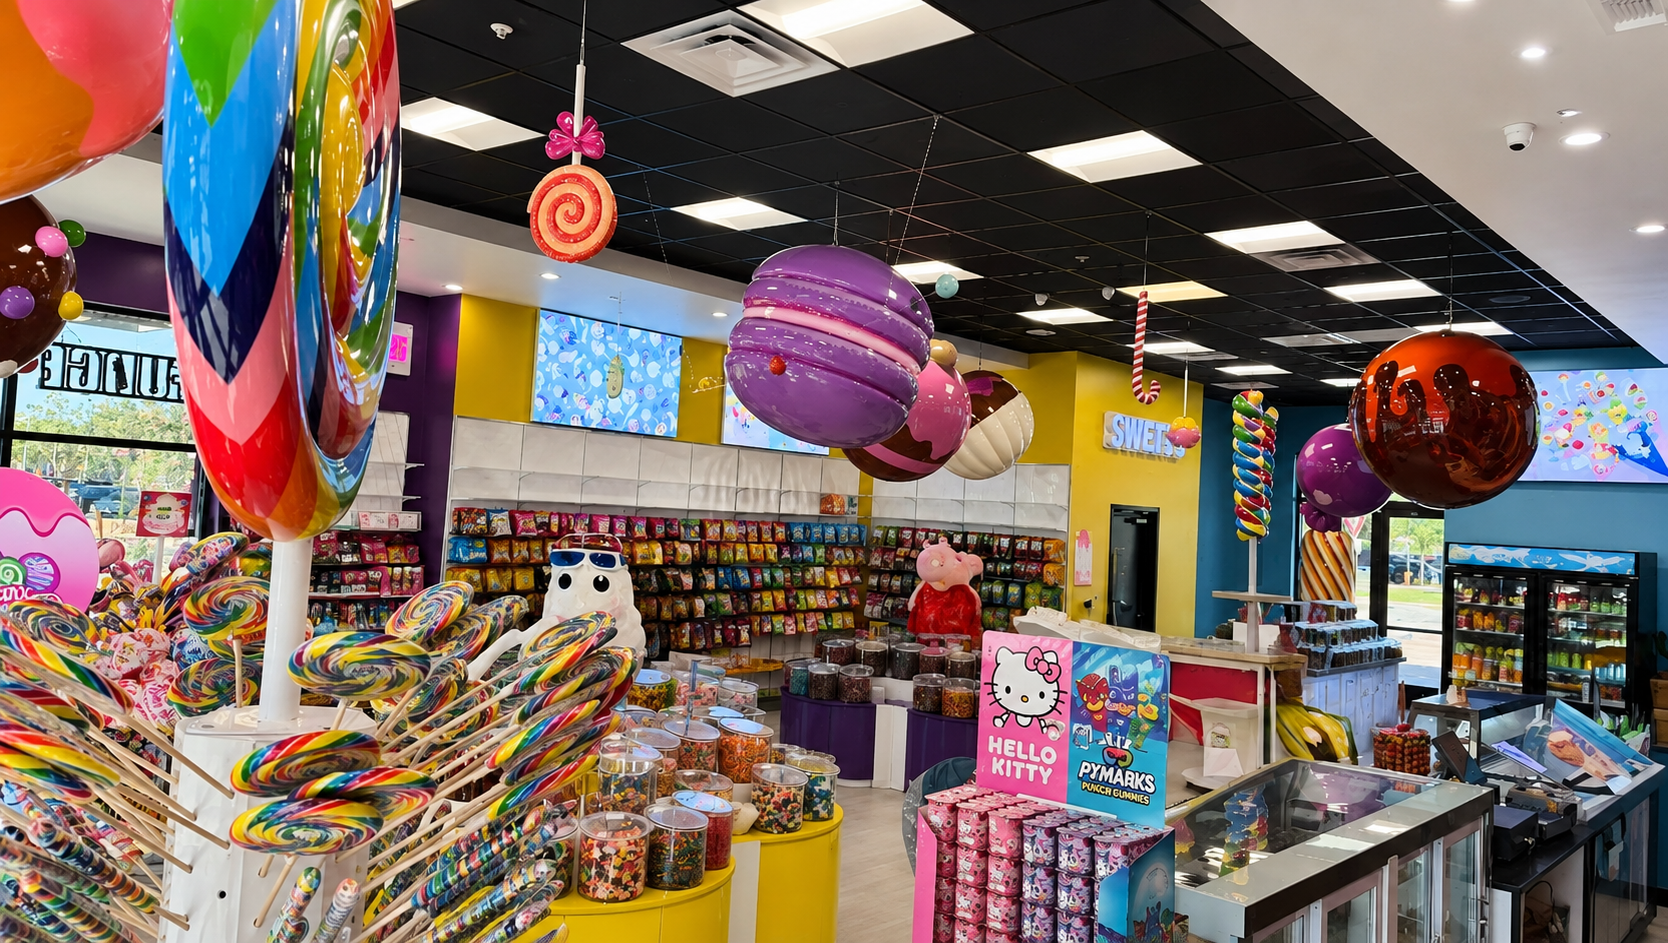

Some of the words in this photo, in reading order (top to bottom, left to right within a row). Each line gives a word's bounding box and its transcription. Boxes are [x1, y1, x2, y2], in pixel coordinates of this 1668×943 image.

[988, 735, 1057, 765] HELLO
[991, 756, 1053, 785] KITTY
[1079, 761, 1156, 793] PYMARKS
